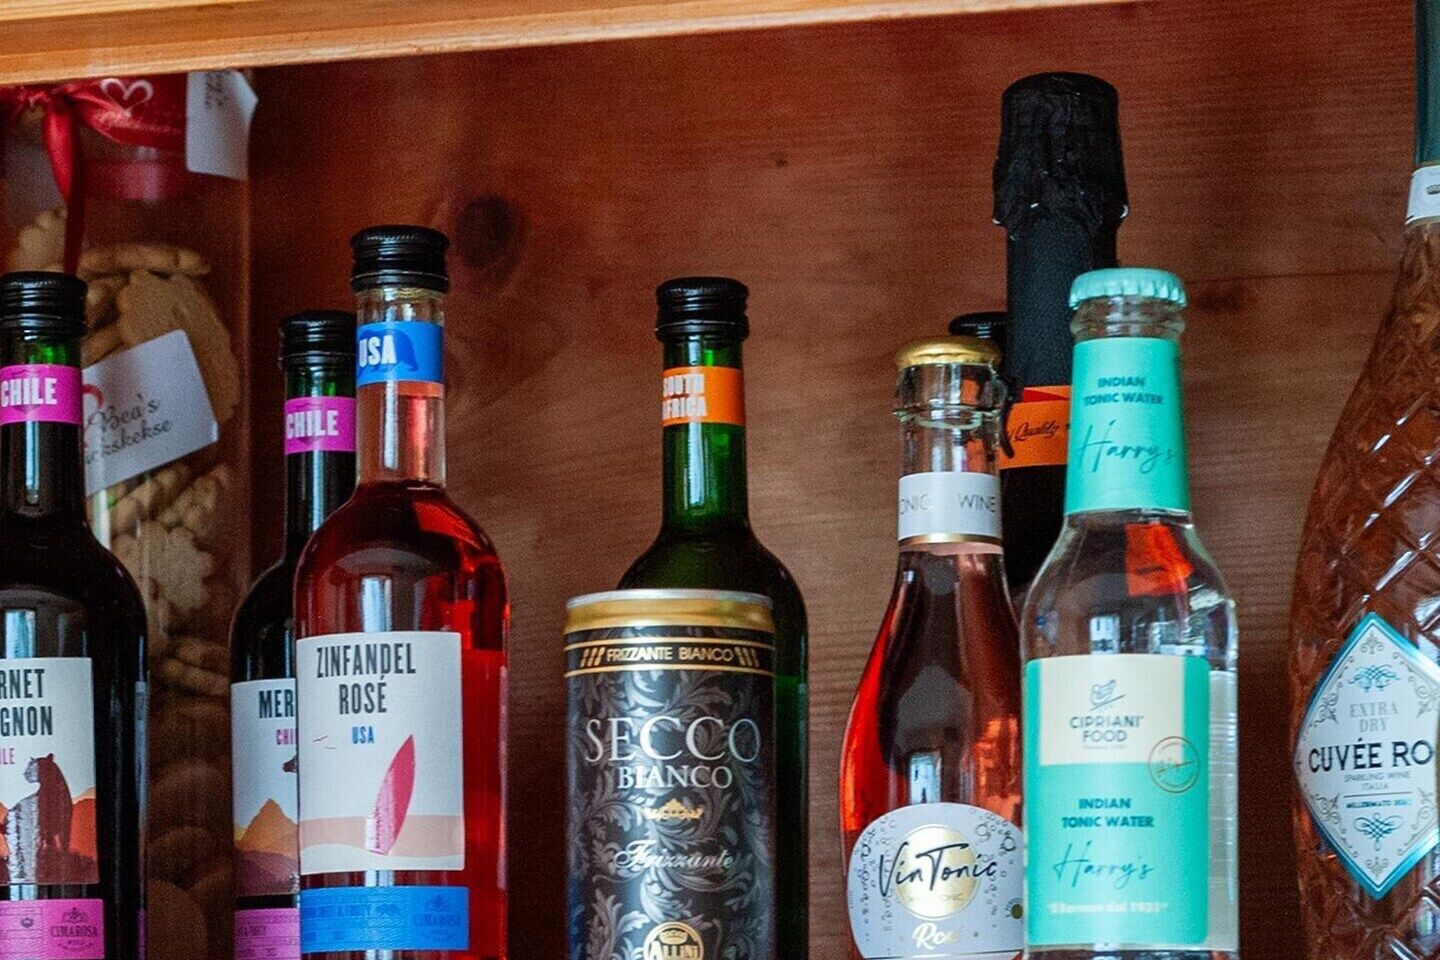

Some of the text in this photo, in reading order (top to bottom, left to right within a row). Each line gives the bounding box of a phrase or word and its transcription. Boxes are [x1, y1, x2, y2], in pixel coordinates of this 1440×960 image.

[1098, 377, 1146, 388] INDIAN
[1, 377, 57, 407] CHILE
[1084, 393, 1164, 406] TONIC WATER
[287, 410, 339, 439] CHILE
[957, 494, 996, 512] WINE
[316, 643, 416, 678] ZINFANDEL
[606, 646, 735, 662] FRIZZANTE BIANCO
[339, 675, 387, 715] ROSÉ
[259, 690, 297, 719] MER
[1350, 702, 1399, 718] EXTRA
[1070, 716, 1142, 729] CIPRIANI
[1360, 718, 1387, 732] DRY
[276, 729, 297, 745] CHI
[352, 726, 375, 744] USA
[585, 715, 760, 763] SECCO
[1083, 730, 1128, 742] FOOD
[1308, 738, 1435, 773] CUVÉE RO
[618, 765, 733, 789] BIANCO
[1079, 798, 1131, 809] INDIAN
[1062, 815, 1155, 828] TONIC WATER
[878, 841, 998, 898] VinTonic
